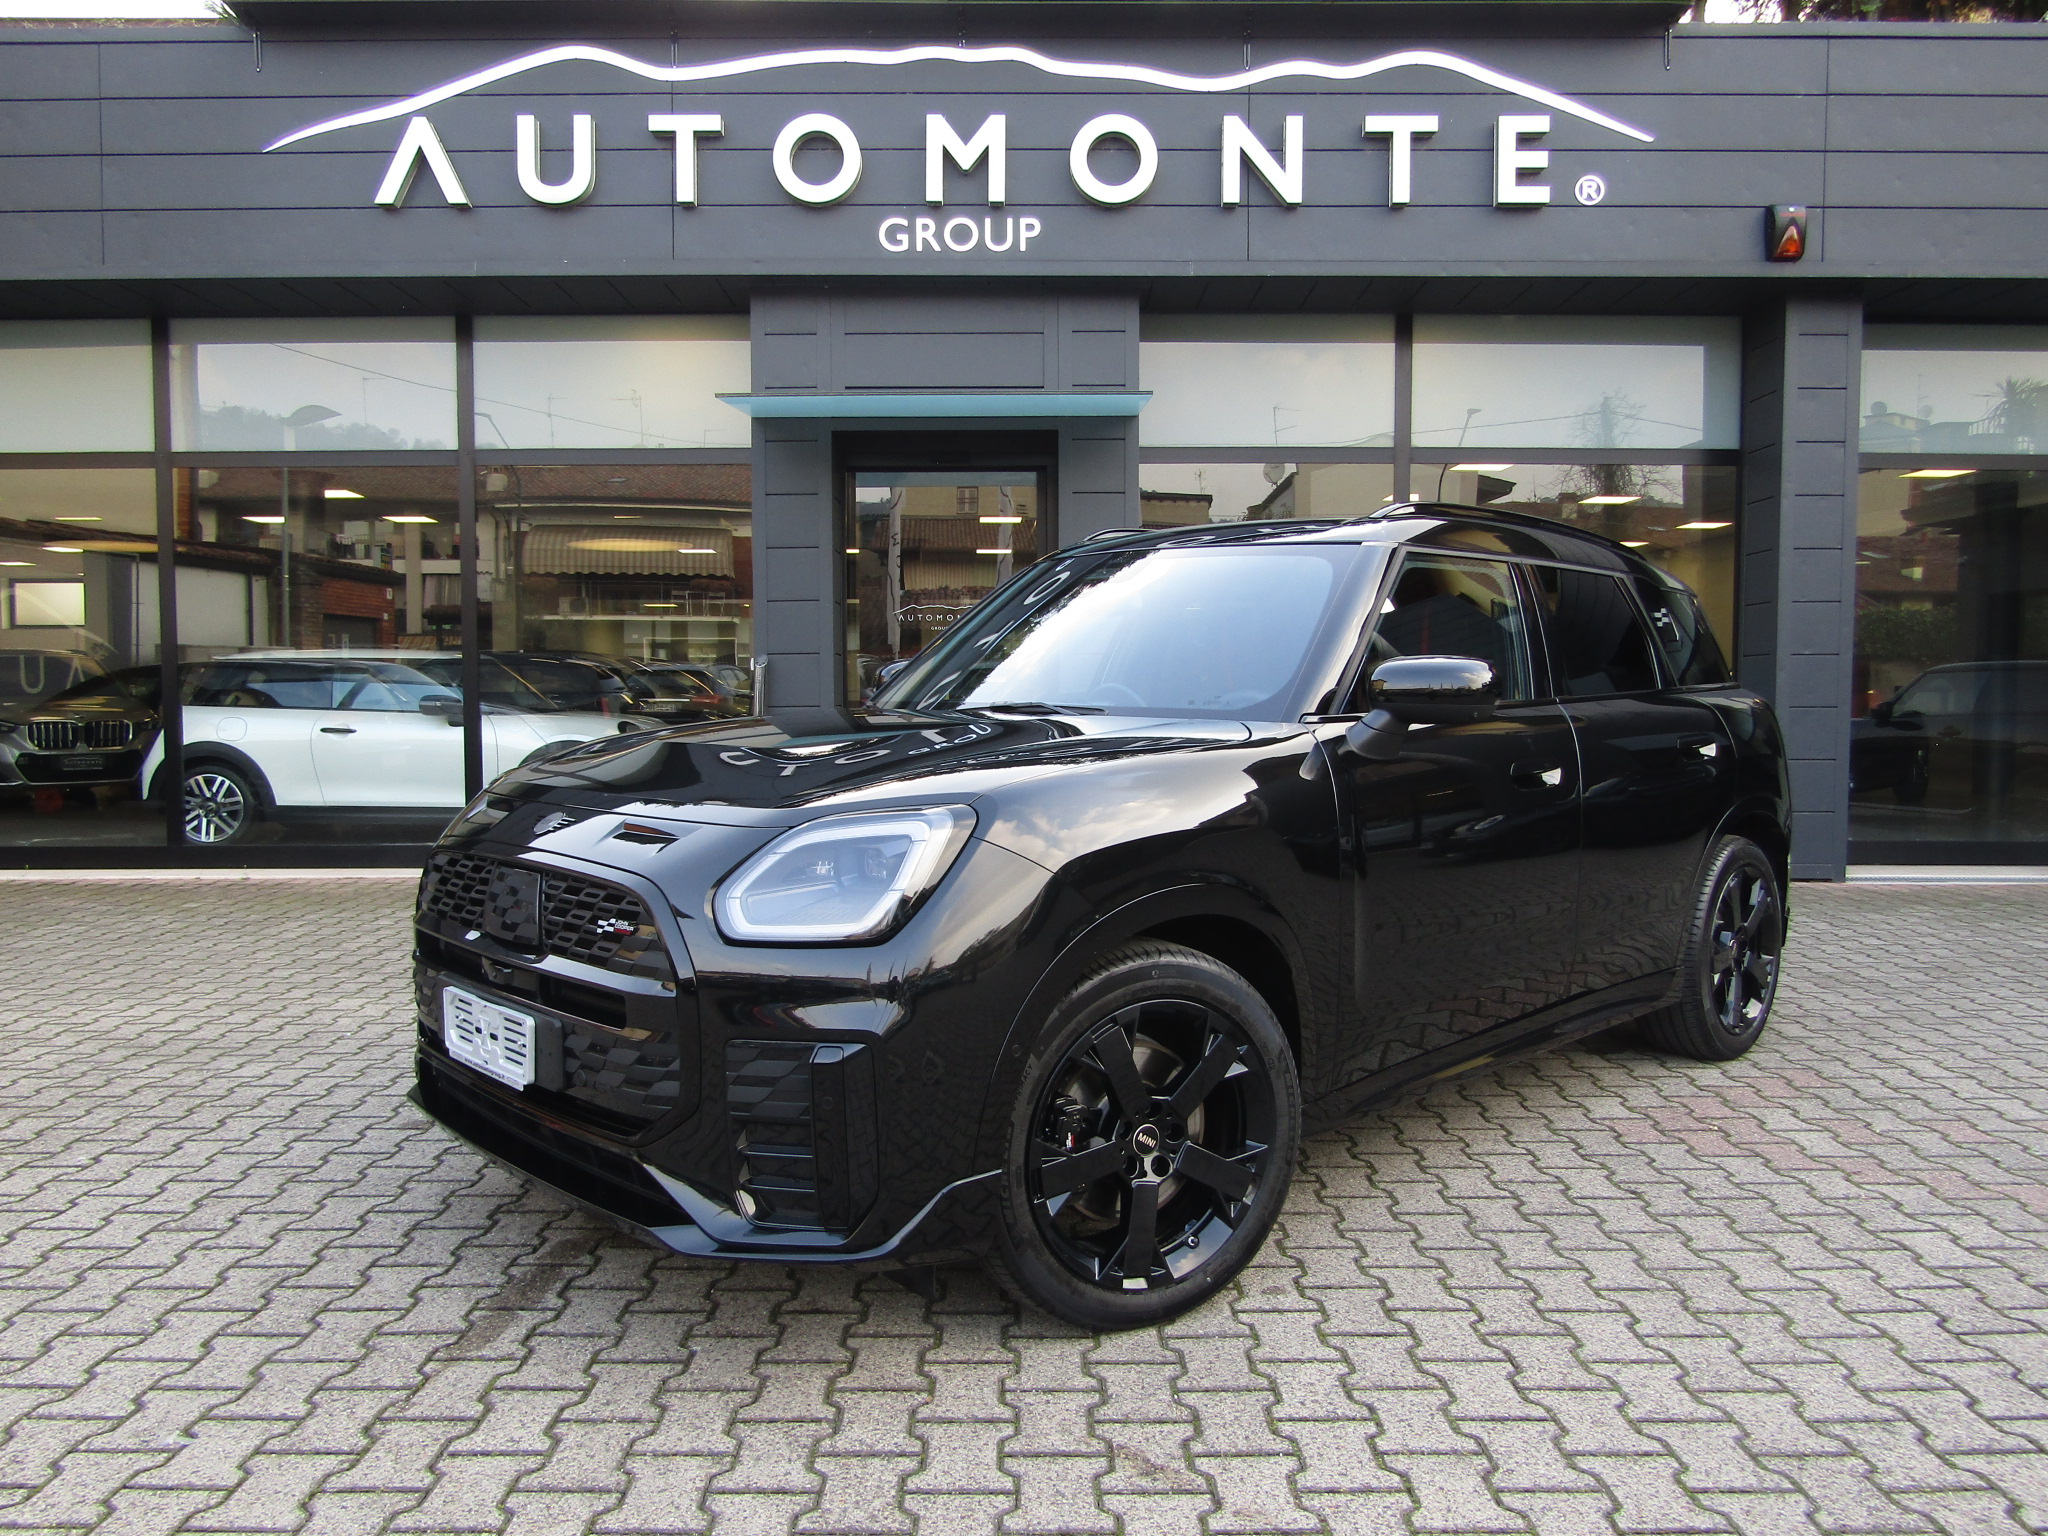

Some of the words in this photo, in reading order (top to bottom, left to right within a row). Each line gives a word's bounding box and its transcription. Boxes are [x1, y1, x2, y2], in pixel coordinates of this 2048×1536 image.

[374, 112, 1551, 207] AUTOMONTE
[878, 216, 1042, 253] GROUP
[1137, 1132, 1157, 1149] MINI
